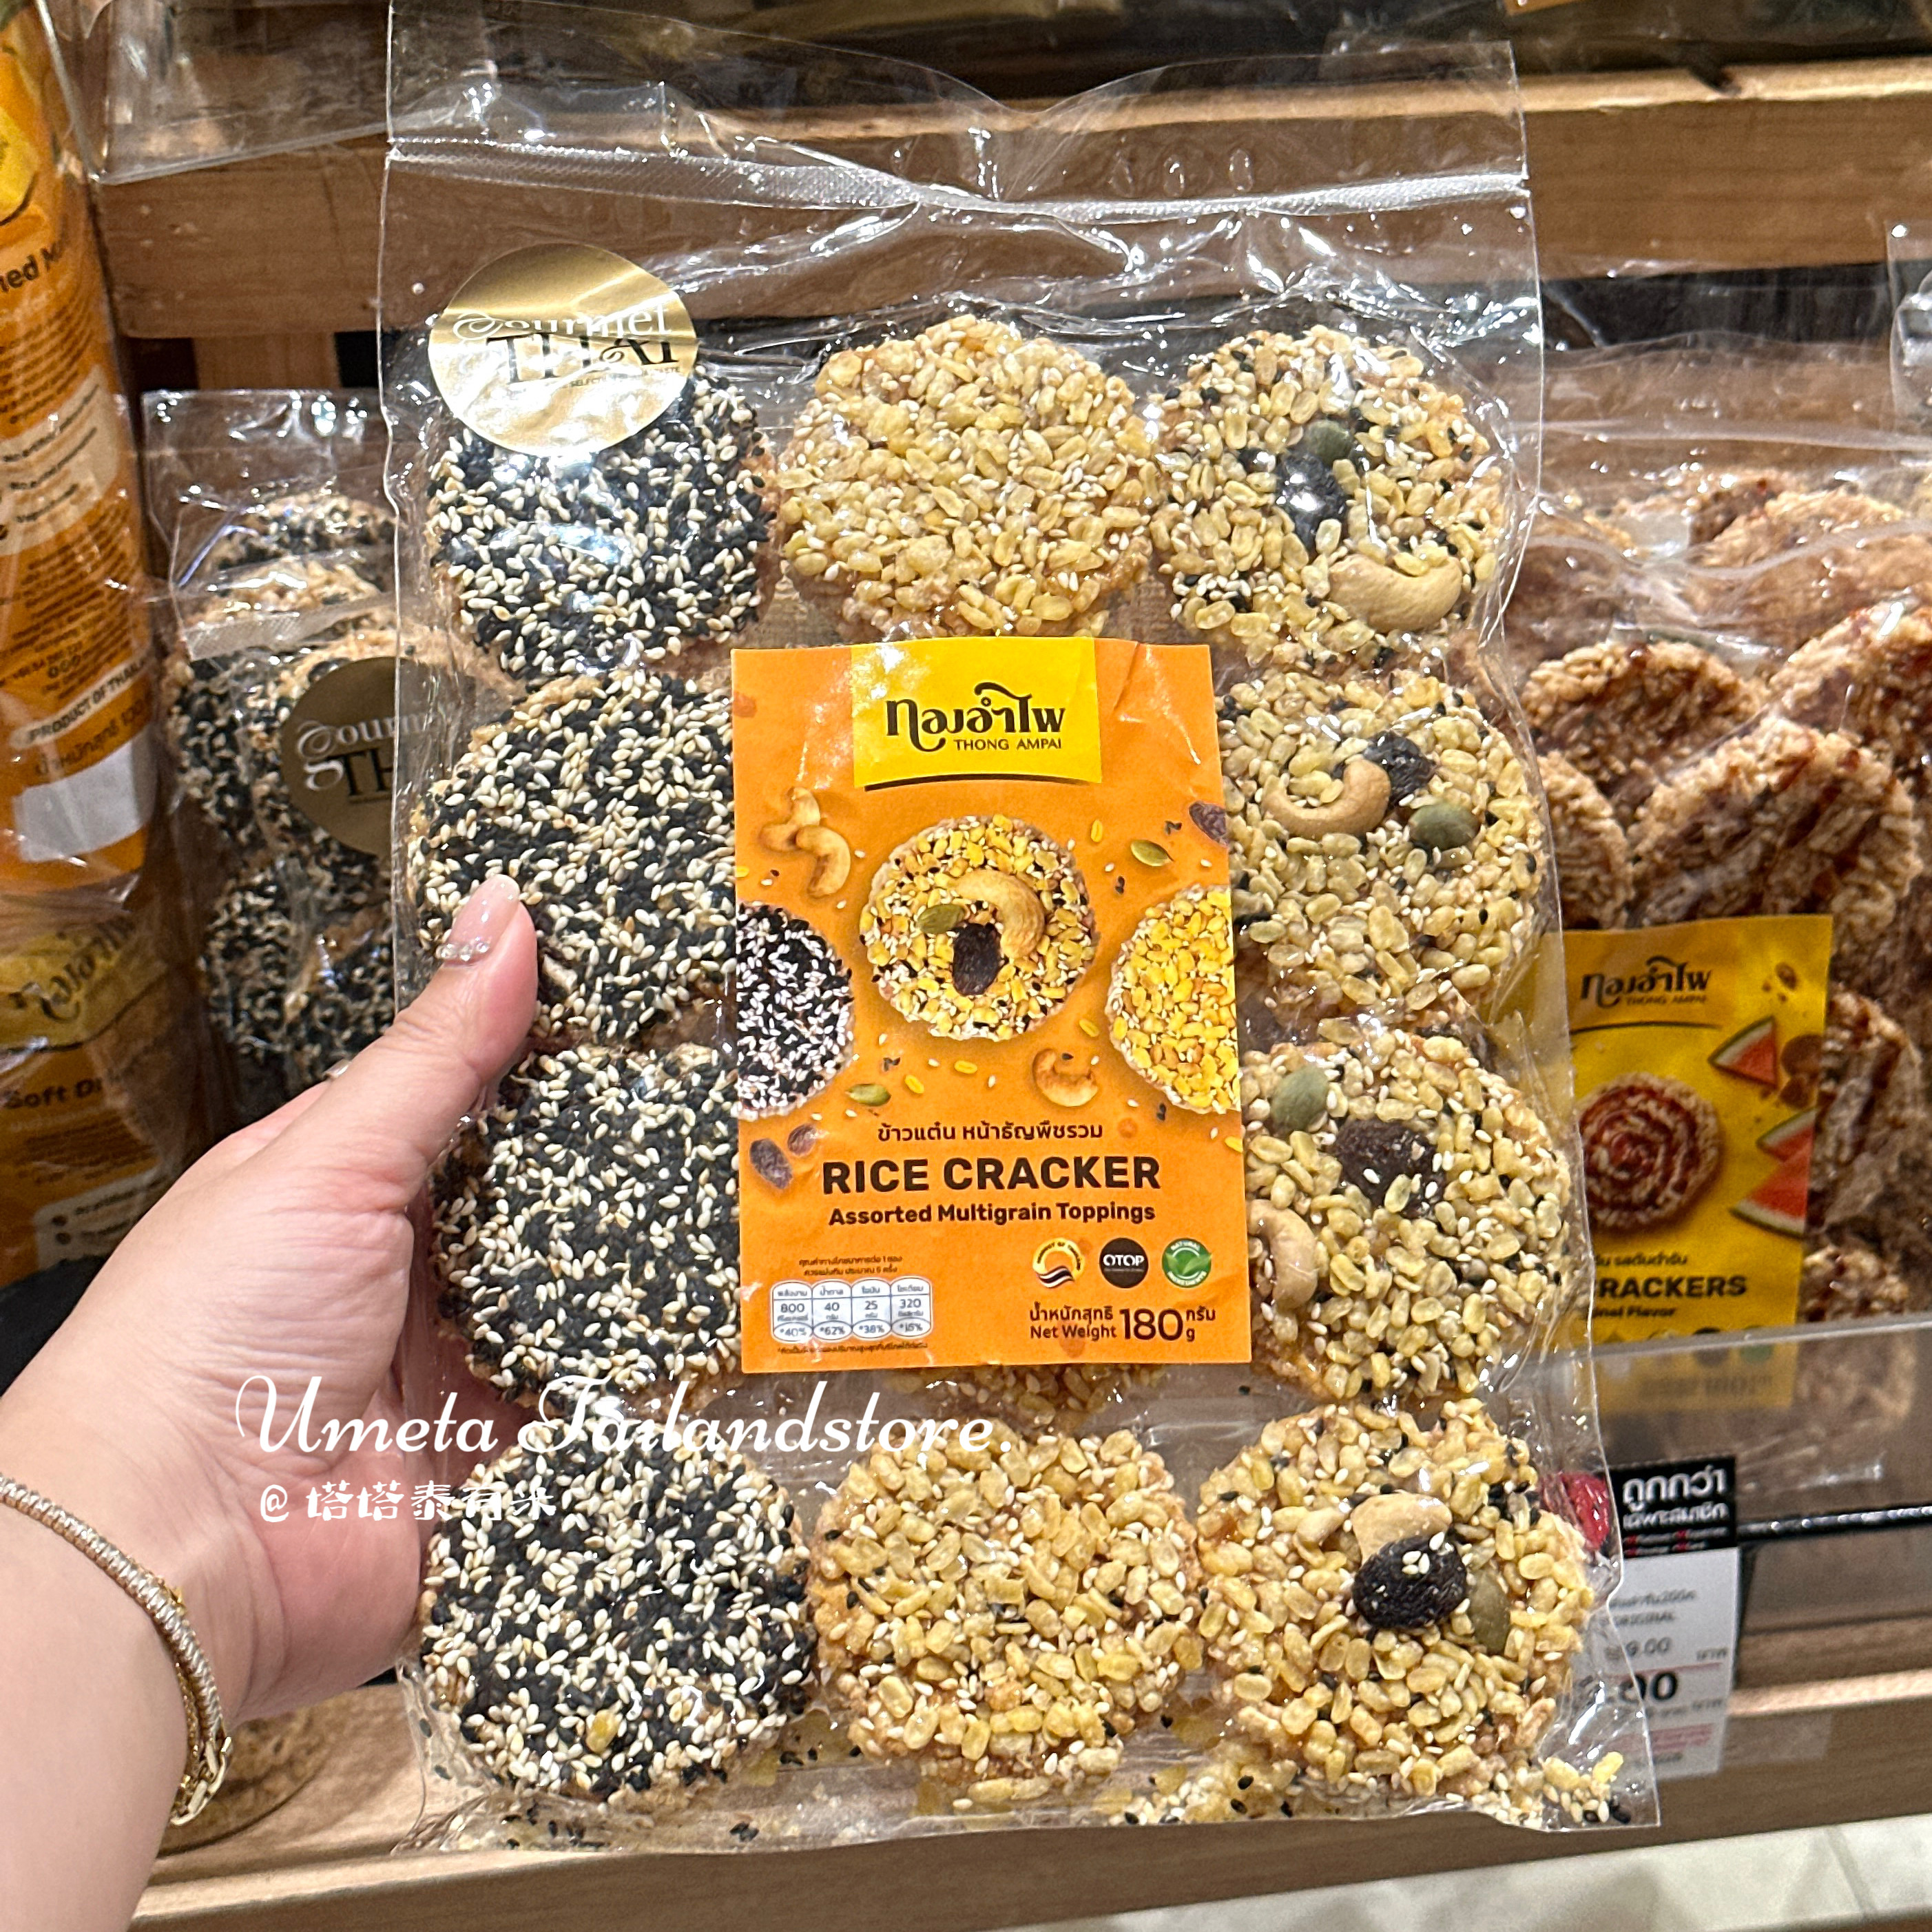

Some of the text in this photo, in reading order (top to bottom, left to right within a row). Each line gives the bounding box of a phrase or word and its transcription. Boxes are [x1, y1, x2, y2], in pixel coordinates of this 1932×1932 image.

[28, 698, 91, 742] PRODUCT
[886, 681, 1066, 753] ทองอำไพ
[953, 738, 1062, 751] THONG AMPAI
[877, 1119, 1103, 1142] ข้าวแต๋น หน้าธัญพืชรวม
[822, 1156, 1161, 1195] RICE CRACKER
[829, 1201, 1156, 1226] Assorted Multigrain Toppings
[1103, 1254, 1145, 1267] OTOP
[1598, 1276, 1747, 1298] RACKERS
[780, 1302, 805, 1313] 800
[824, 1301, 840, 1312] 40
[864, 1300, 879, 1311] 25
[899, 1298, 922, 1309] 320
[1029, 1300, 1114, 1326] น้ำหนักสุทธิ
[1185, 1305, 1216, 1322] กรัม
[1030, 1325, 1118, 1342] Net Weight
[1119, 1307, 1184, 1342] 180
[1185, 1327, 1196, 1342] g
[1623, 1464, 1727, 1513] ถูกกว่า
